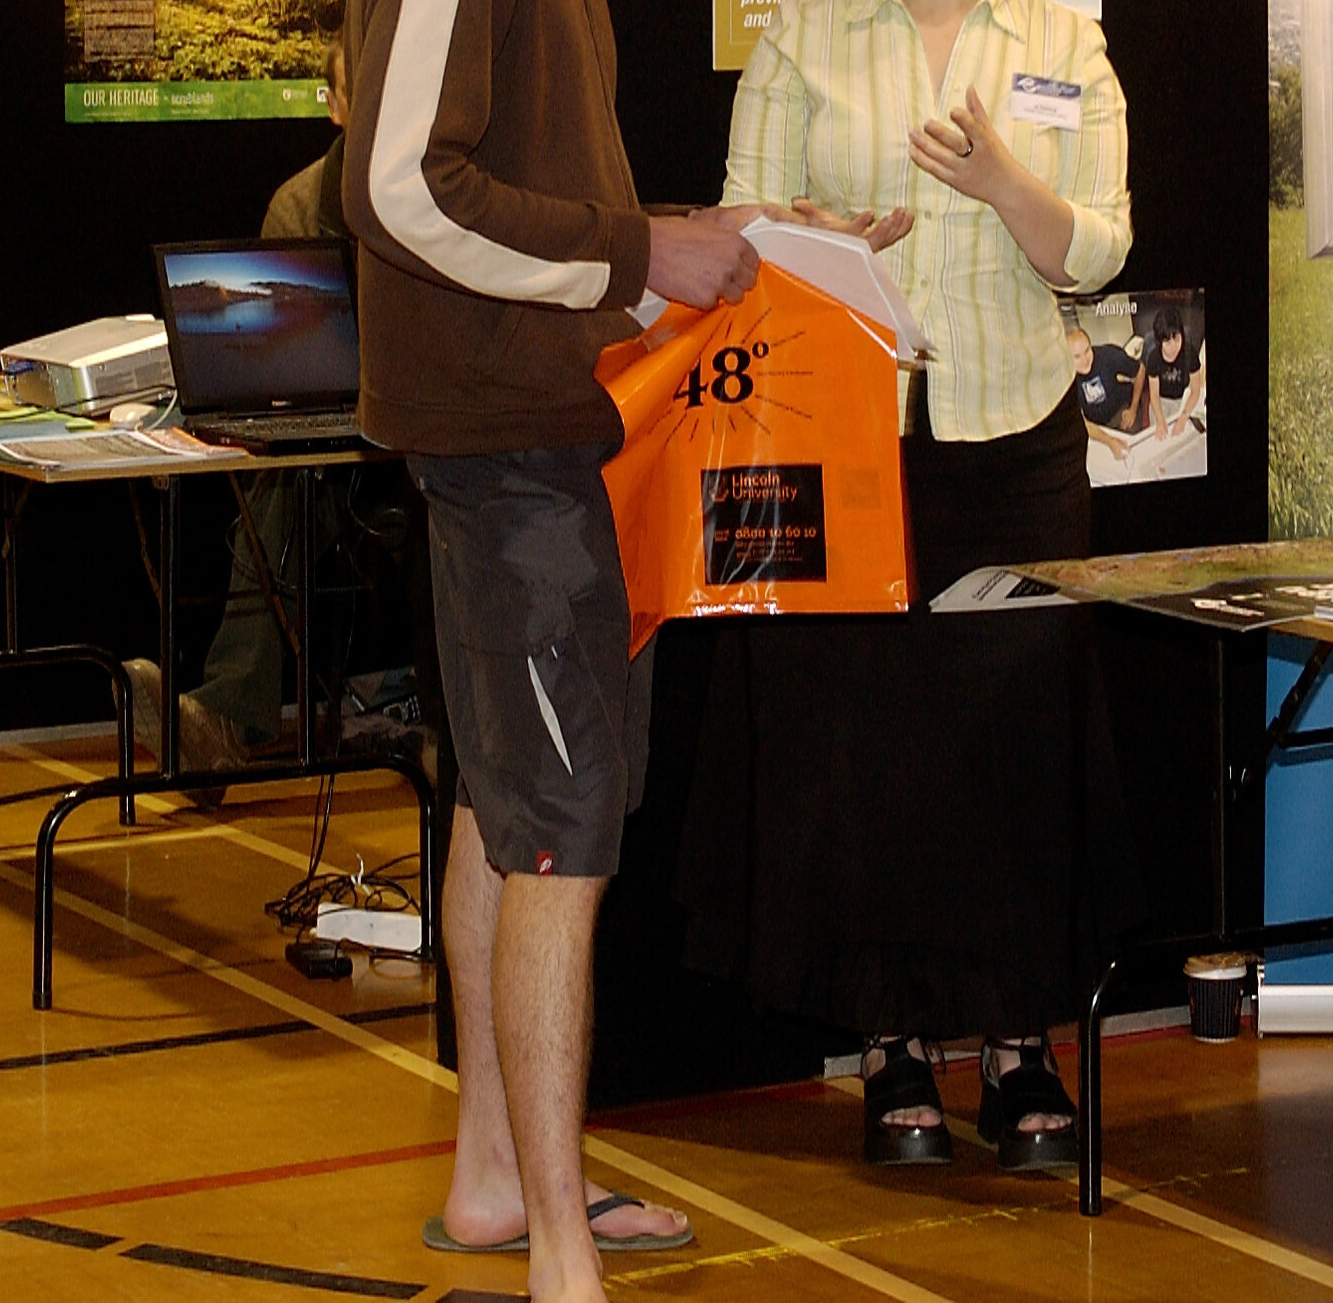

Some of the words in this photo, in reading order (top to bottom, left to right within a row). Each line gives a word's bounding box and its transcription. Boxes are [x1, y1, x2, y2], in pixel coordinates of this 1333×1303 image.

[743, 9, 772, 28] and
[83, 89, 106, 107] OUR
[109, 88, 159, 107] HERITAGE
[732, 470, 781, 488] Lincoln
[732, 485, 798, 502] University
